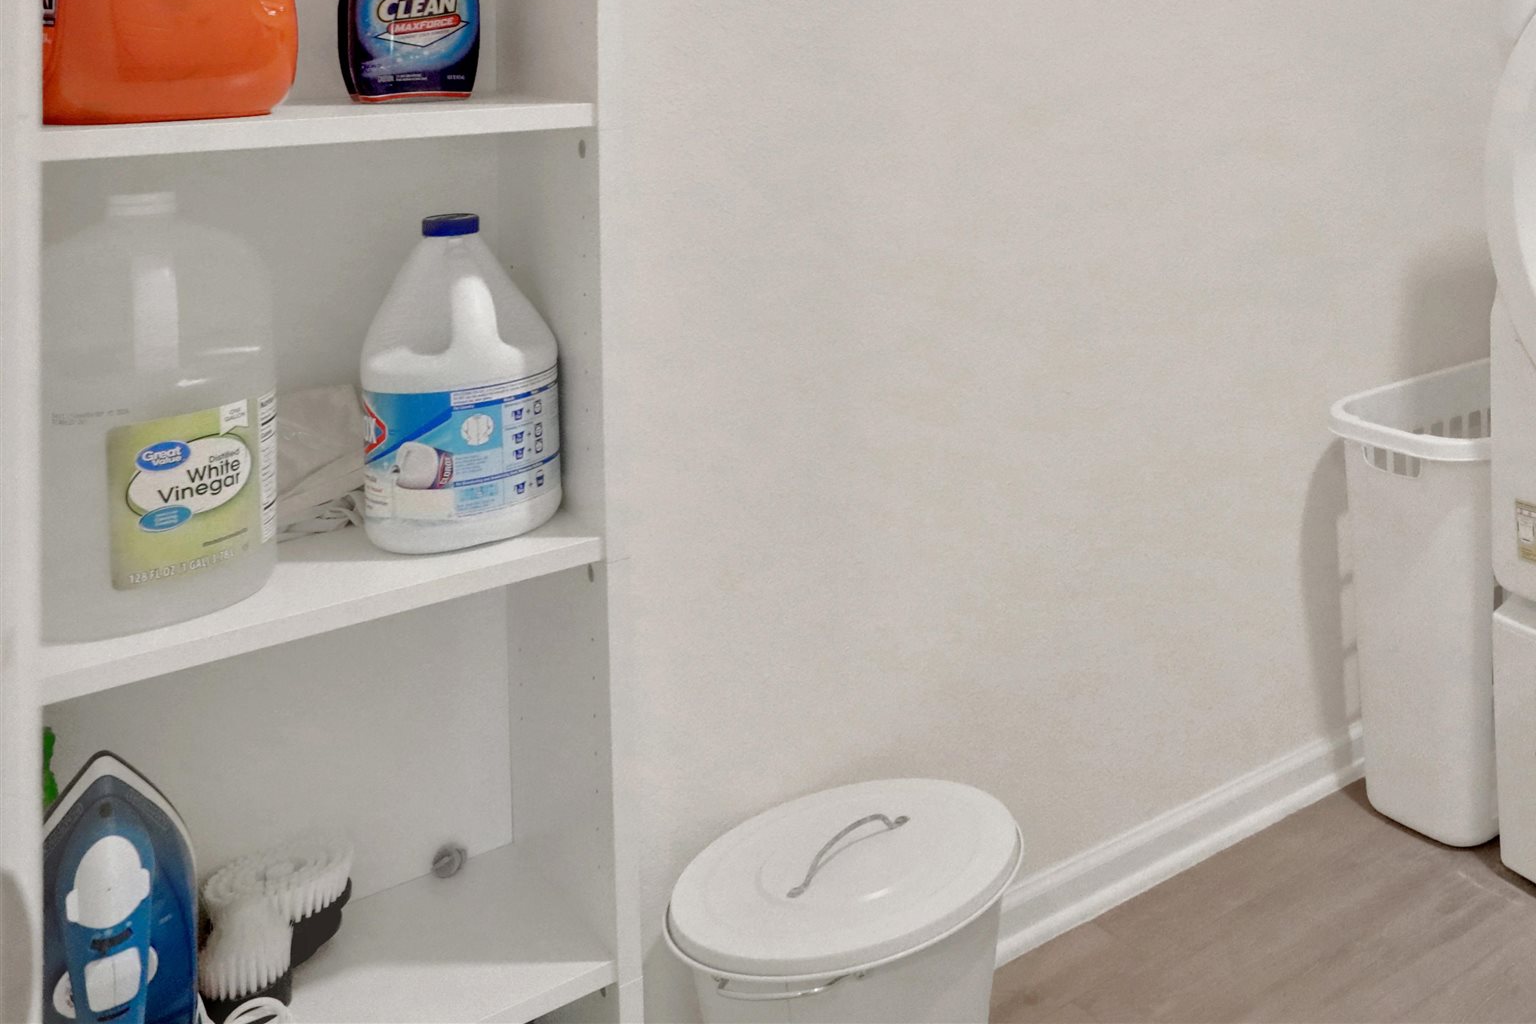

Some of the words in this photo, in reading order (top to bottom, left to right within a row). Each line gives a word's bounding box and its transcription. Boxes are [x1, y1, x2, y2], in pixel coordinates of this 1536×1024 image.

[394, 16, 455, 33] MAXFORCE
[142, 445, 183, 462] Great
[152, 454, 182, 467] Value
[208, 448, 240, 464] Distilled
[187, 459, 241, 484] White
[157, 472, 241, 504] Vinegar
